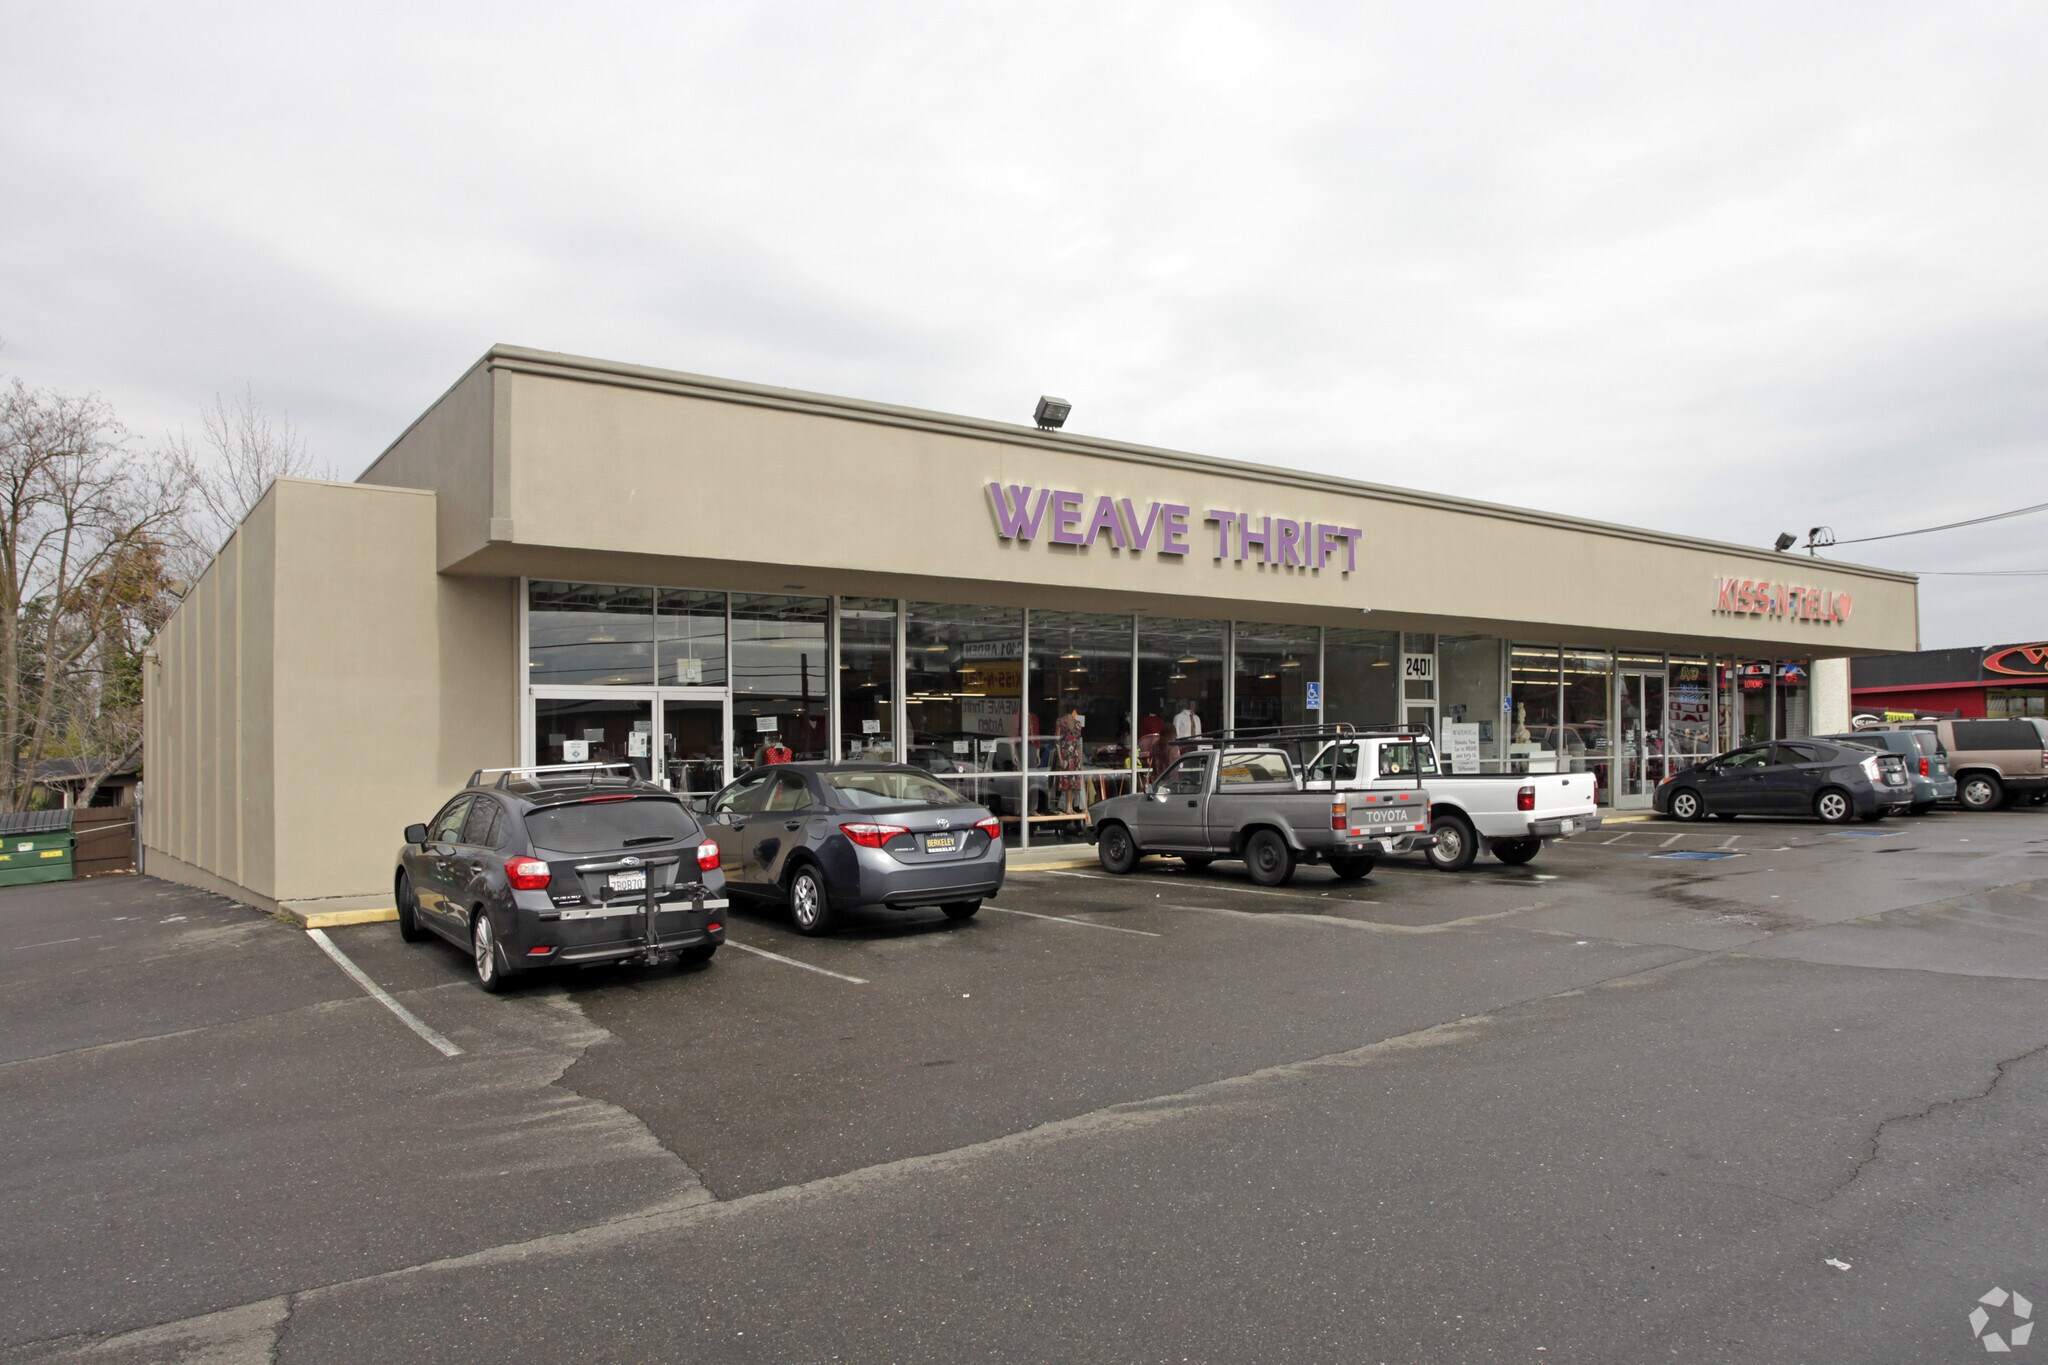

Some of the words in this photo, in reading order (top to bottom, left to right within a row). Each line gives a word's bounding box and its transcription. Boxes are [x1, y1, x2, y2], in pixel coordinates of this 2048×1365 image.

[985, 482, 1190, 555] WEAVE
[1204, 509, 1363, 572] THRIFT
[1406, 658, 1431, 676] 2401
[1366, 810, 1408, 823] TOYOTA
[926, 838, 955, 847] BERKELEY
